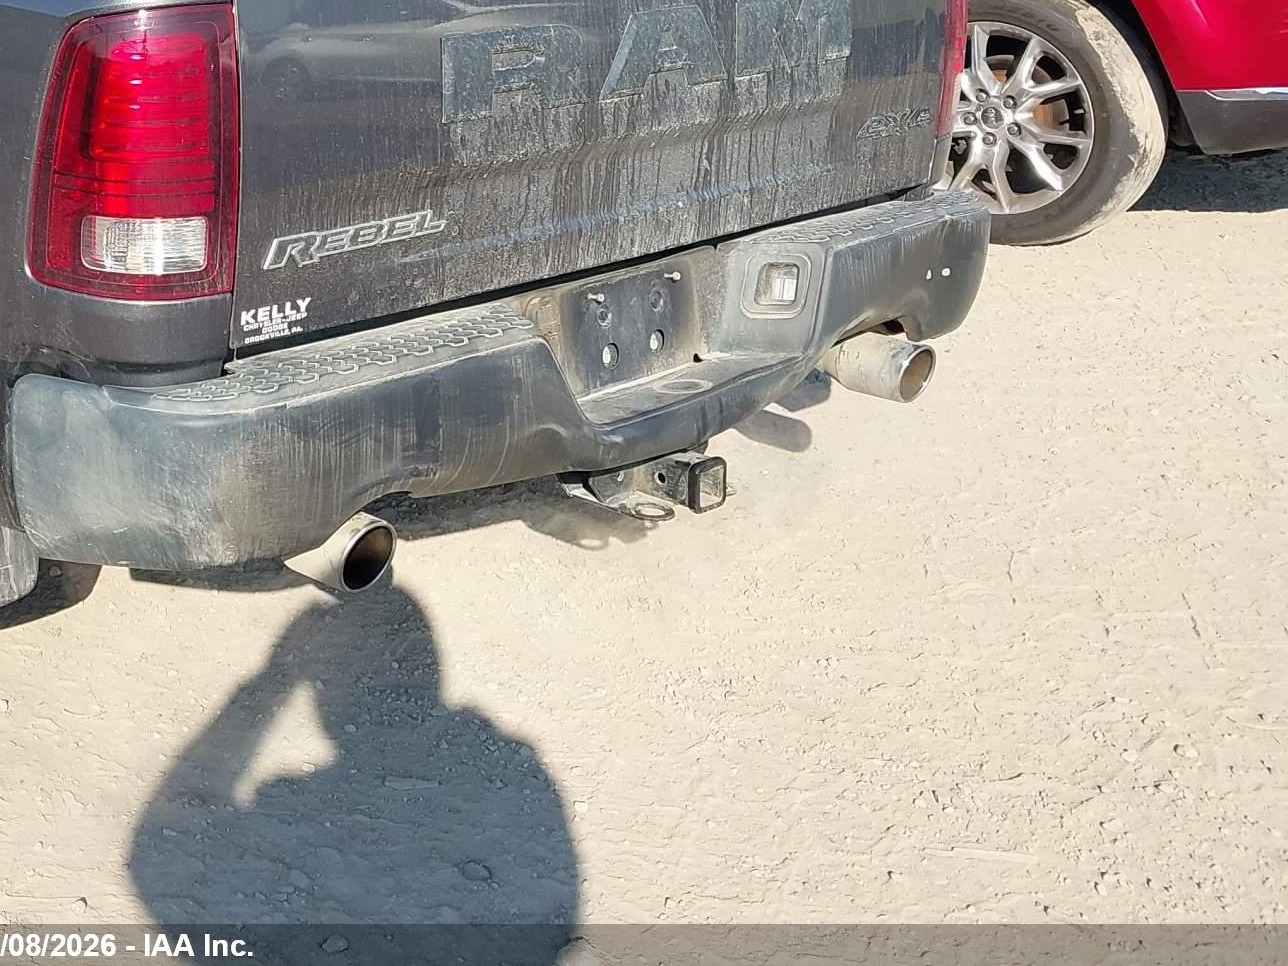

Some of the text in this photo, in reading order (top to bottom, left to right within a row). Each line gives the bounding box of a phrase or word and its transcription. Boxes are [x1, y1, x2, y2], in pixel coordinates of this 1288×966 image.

[262, 209, 447, 270] REBEL
[240, 297, 312, 326] KELLY
[261, 322, 289, 334] DODGE
